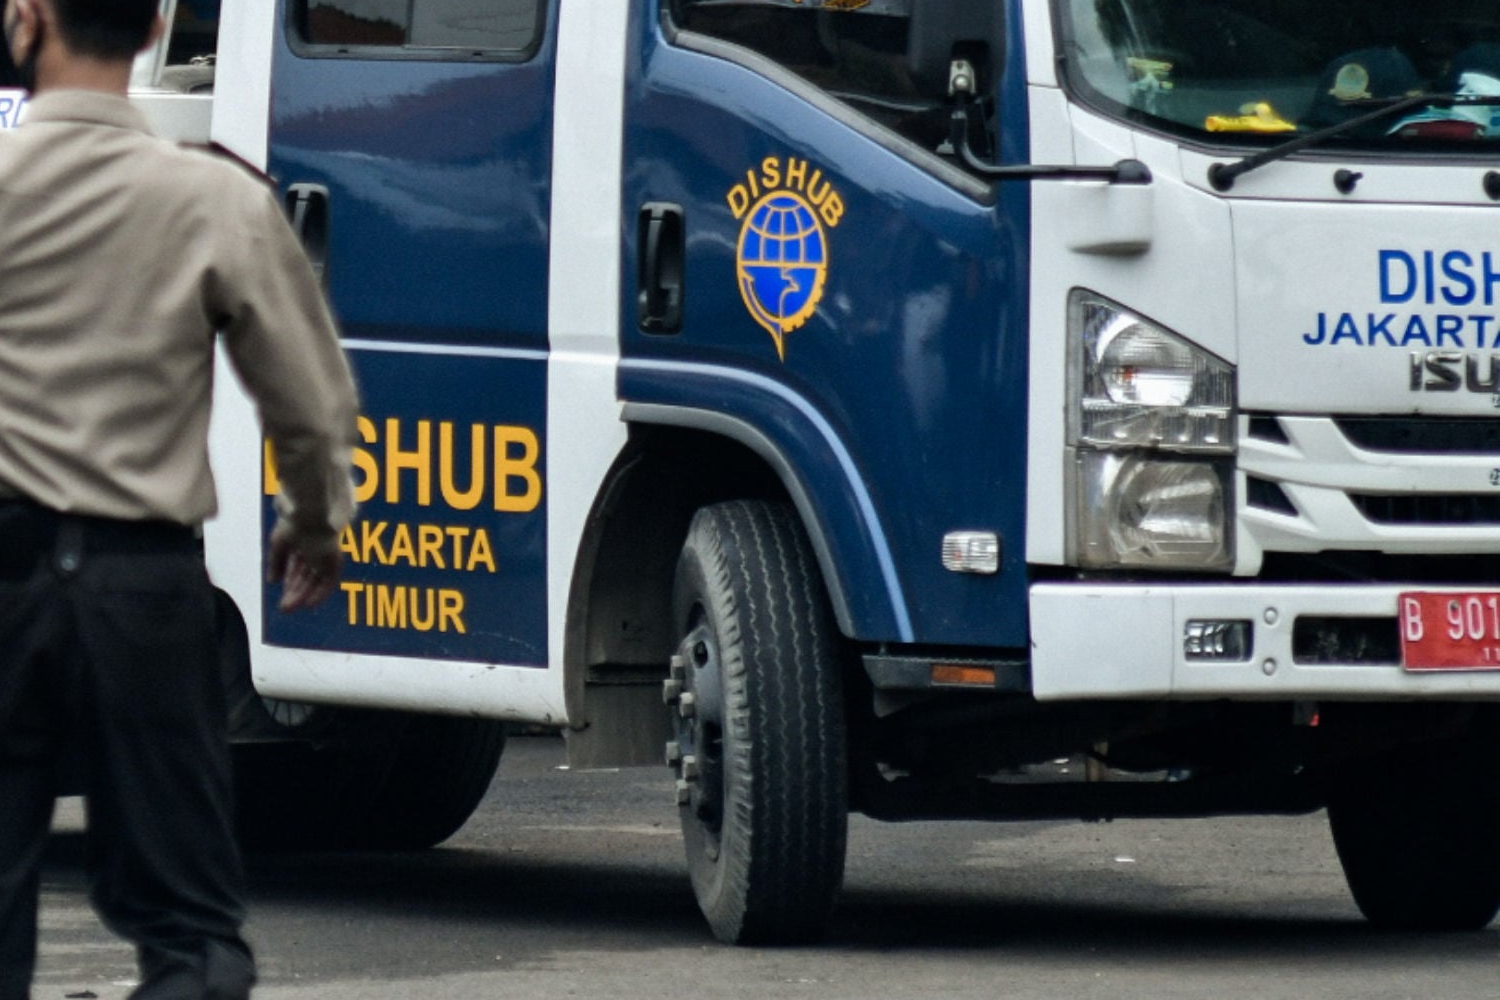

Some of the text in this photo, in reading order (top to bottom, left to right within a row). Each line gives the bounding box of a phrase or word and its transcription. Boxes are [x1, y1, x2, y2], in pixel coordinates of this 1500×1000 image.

[727, 157, 845, 227] DISHUB
[1302, 312, 1500, 348] JAKART
[1409, 351, 1500, 393] ISU
[264, 416, 542, 513] SHUB
[340, 520, 496, 573] AKARTA
[340, 581, 466, 634] TIMUR
[1405, 597, 1423, 642] B
